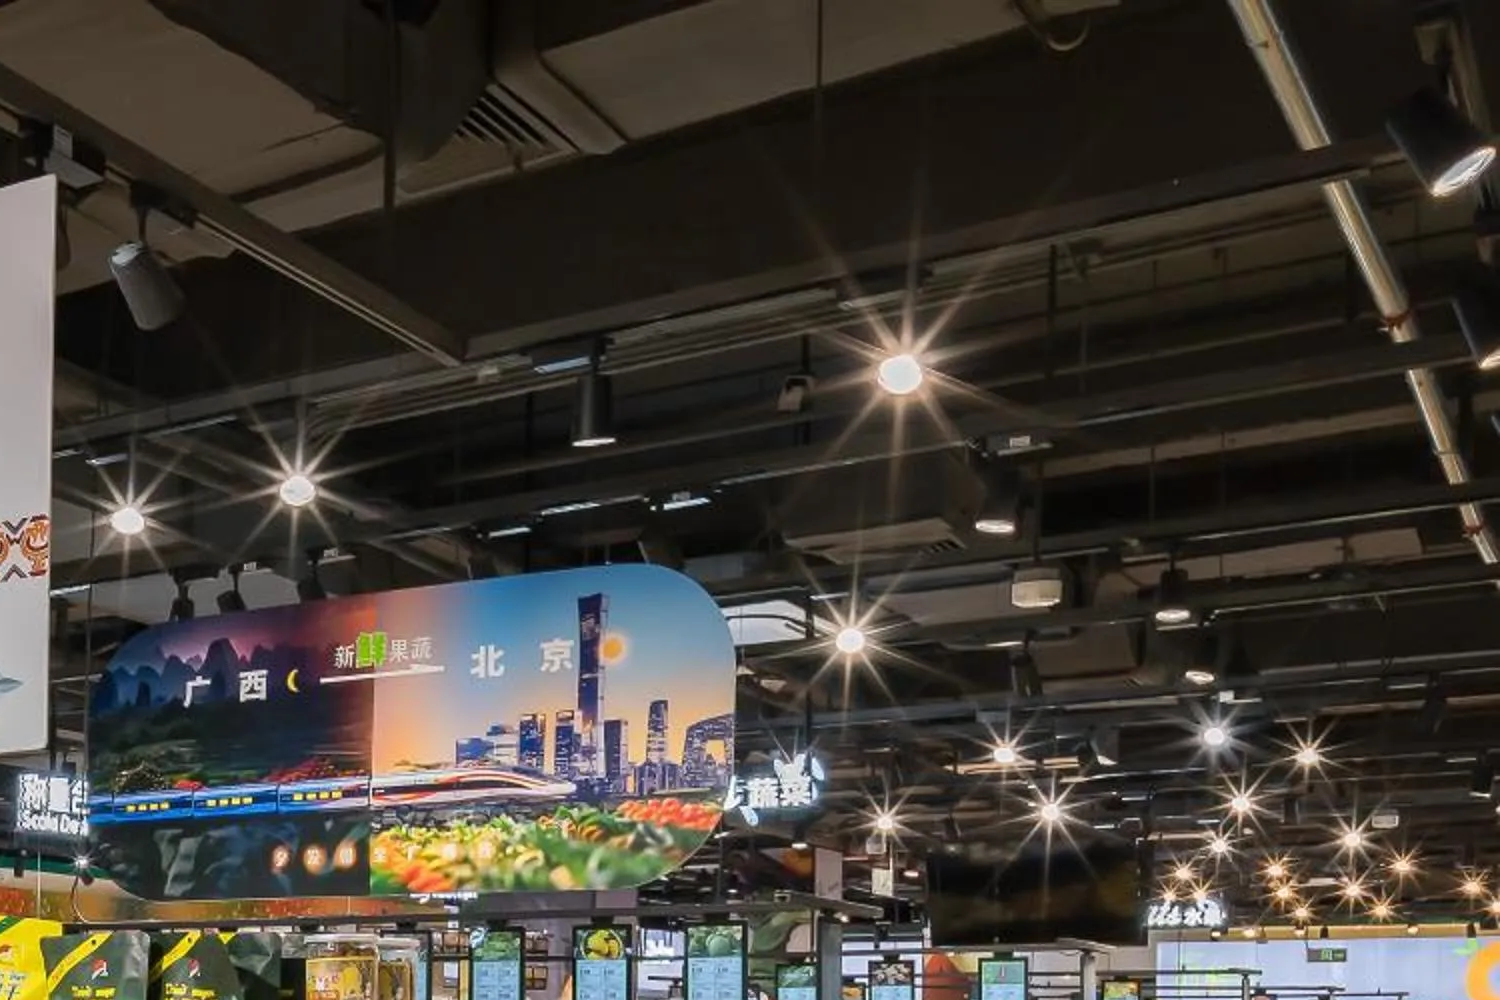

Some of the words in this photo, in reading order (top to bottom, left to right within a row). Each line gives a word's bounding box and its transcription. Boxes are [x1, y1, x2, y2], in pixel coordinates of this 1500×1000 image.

[333, 632, 432, 669] 新鲜果蔬
[470, 638, 575, 679] 北京
[184, 669, 269, 709] 广西
